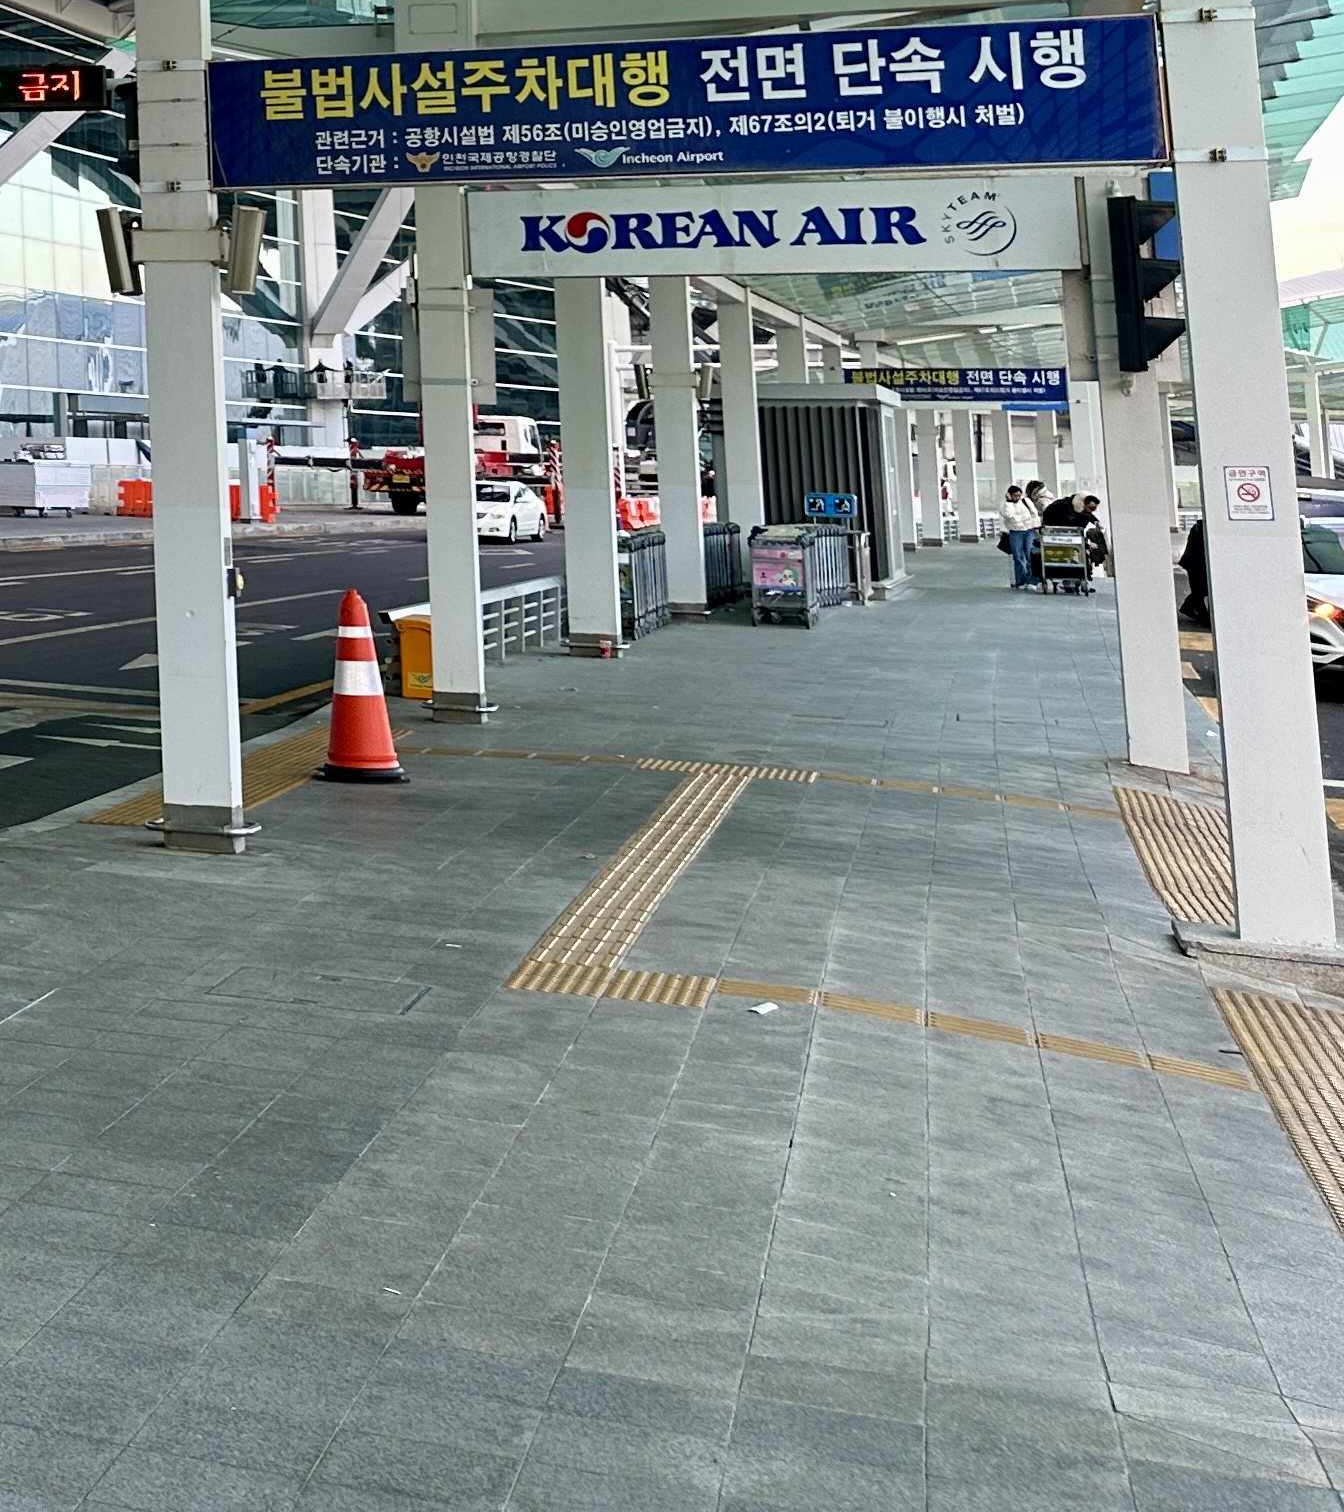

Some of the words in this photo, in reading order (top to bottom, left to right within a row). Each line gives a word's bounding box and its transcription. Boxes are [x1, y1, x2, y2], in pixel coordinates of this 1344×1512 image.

[18, 70, 81, 102] 금지
[260, 50, 670, 120] 불법사설주차대행
[700, 43, 807, 102] 전면
[832, 36, 946, 96] 단속
[969, 28, 1087, 90] 시행
[315, 130, 385, 150] 관련근거
[405, 126, 495, 148] 공항시설법
[729, 108, 876, 136] 제67조의2(퇴거
[883, 105, 966, 129] 불이행시
[975, 101, 1024, 127] 처벌)
[316, 154, 386, 175] 단속기관
[622, 151, 673, 165] Incheon
[676, 151, 724, 165] Airport
[520, 209, 779, 254] KOREAN
[790, 206, 927, 246] AIR
[941, 192, 997, 244] SKYTEAM
[966, 370, 994, 385] 전면
[999, 370, 1027, 385] 단속
[1031, 370, 1061, 385] 시행
